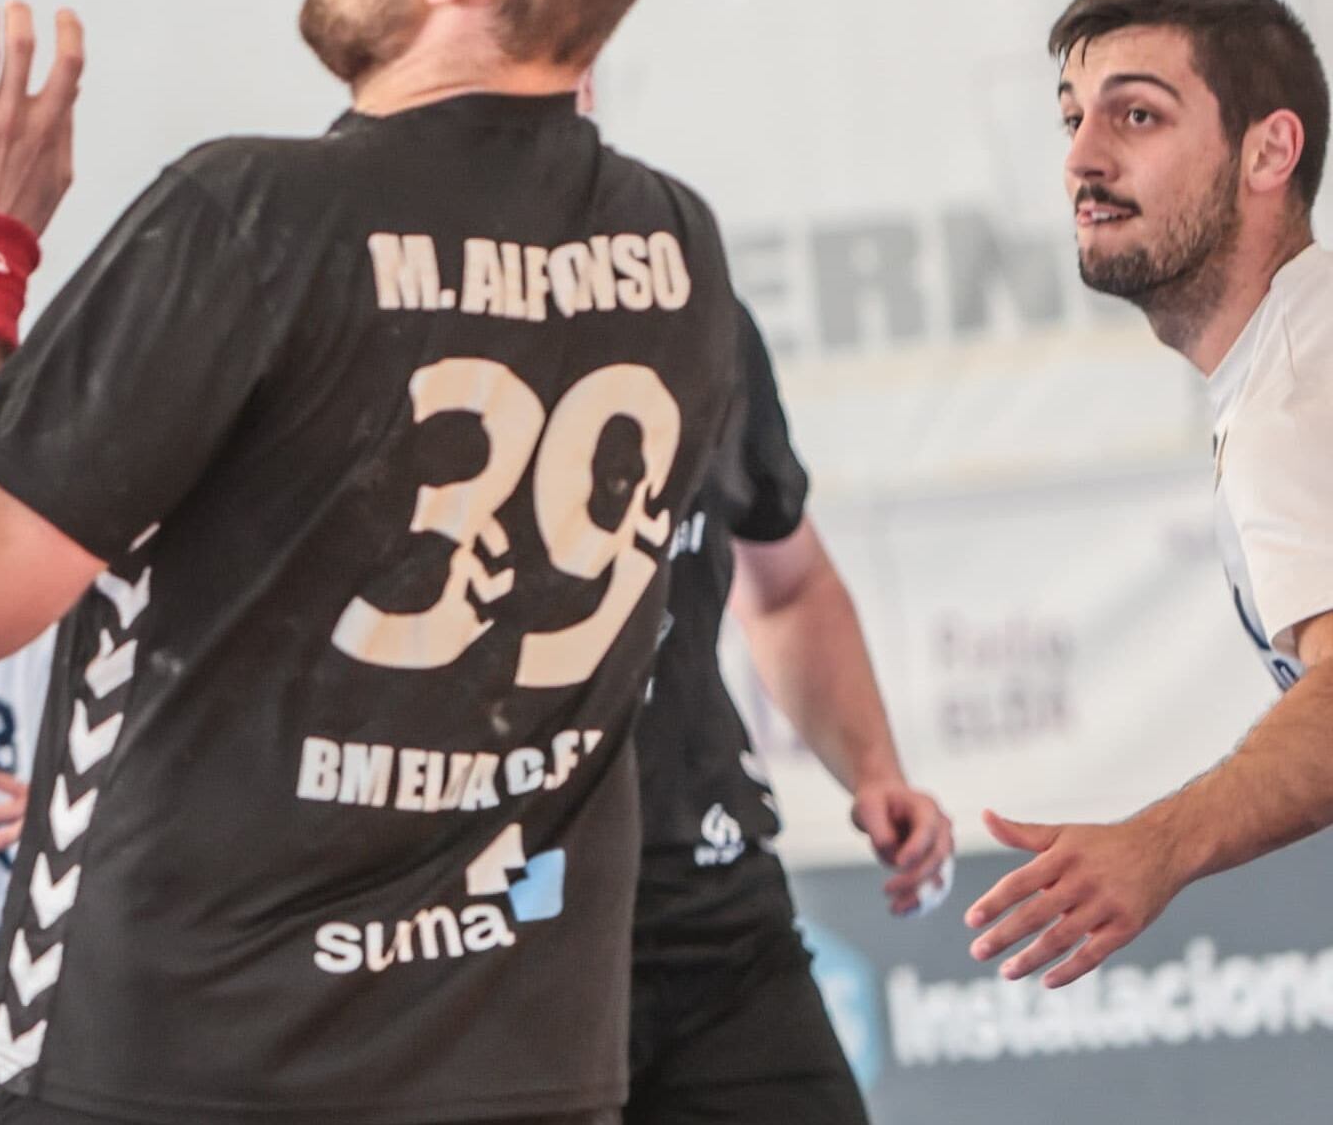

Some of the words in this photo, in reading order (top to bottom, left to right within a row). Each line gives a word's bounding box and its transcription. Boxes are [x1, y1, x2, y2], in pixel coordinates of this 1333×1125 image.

[368, 231, 456, 310] M.
[460, 231, 692, 322] ALFONSO
[332, 357, 681, 688] 39
[296, 736, 394, 808] BM
